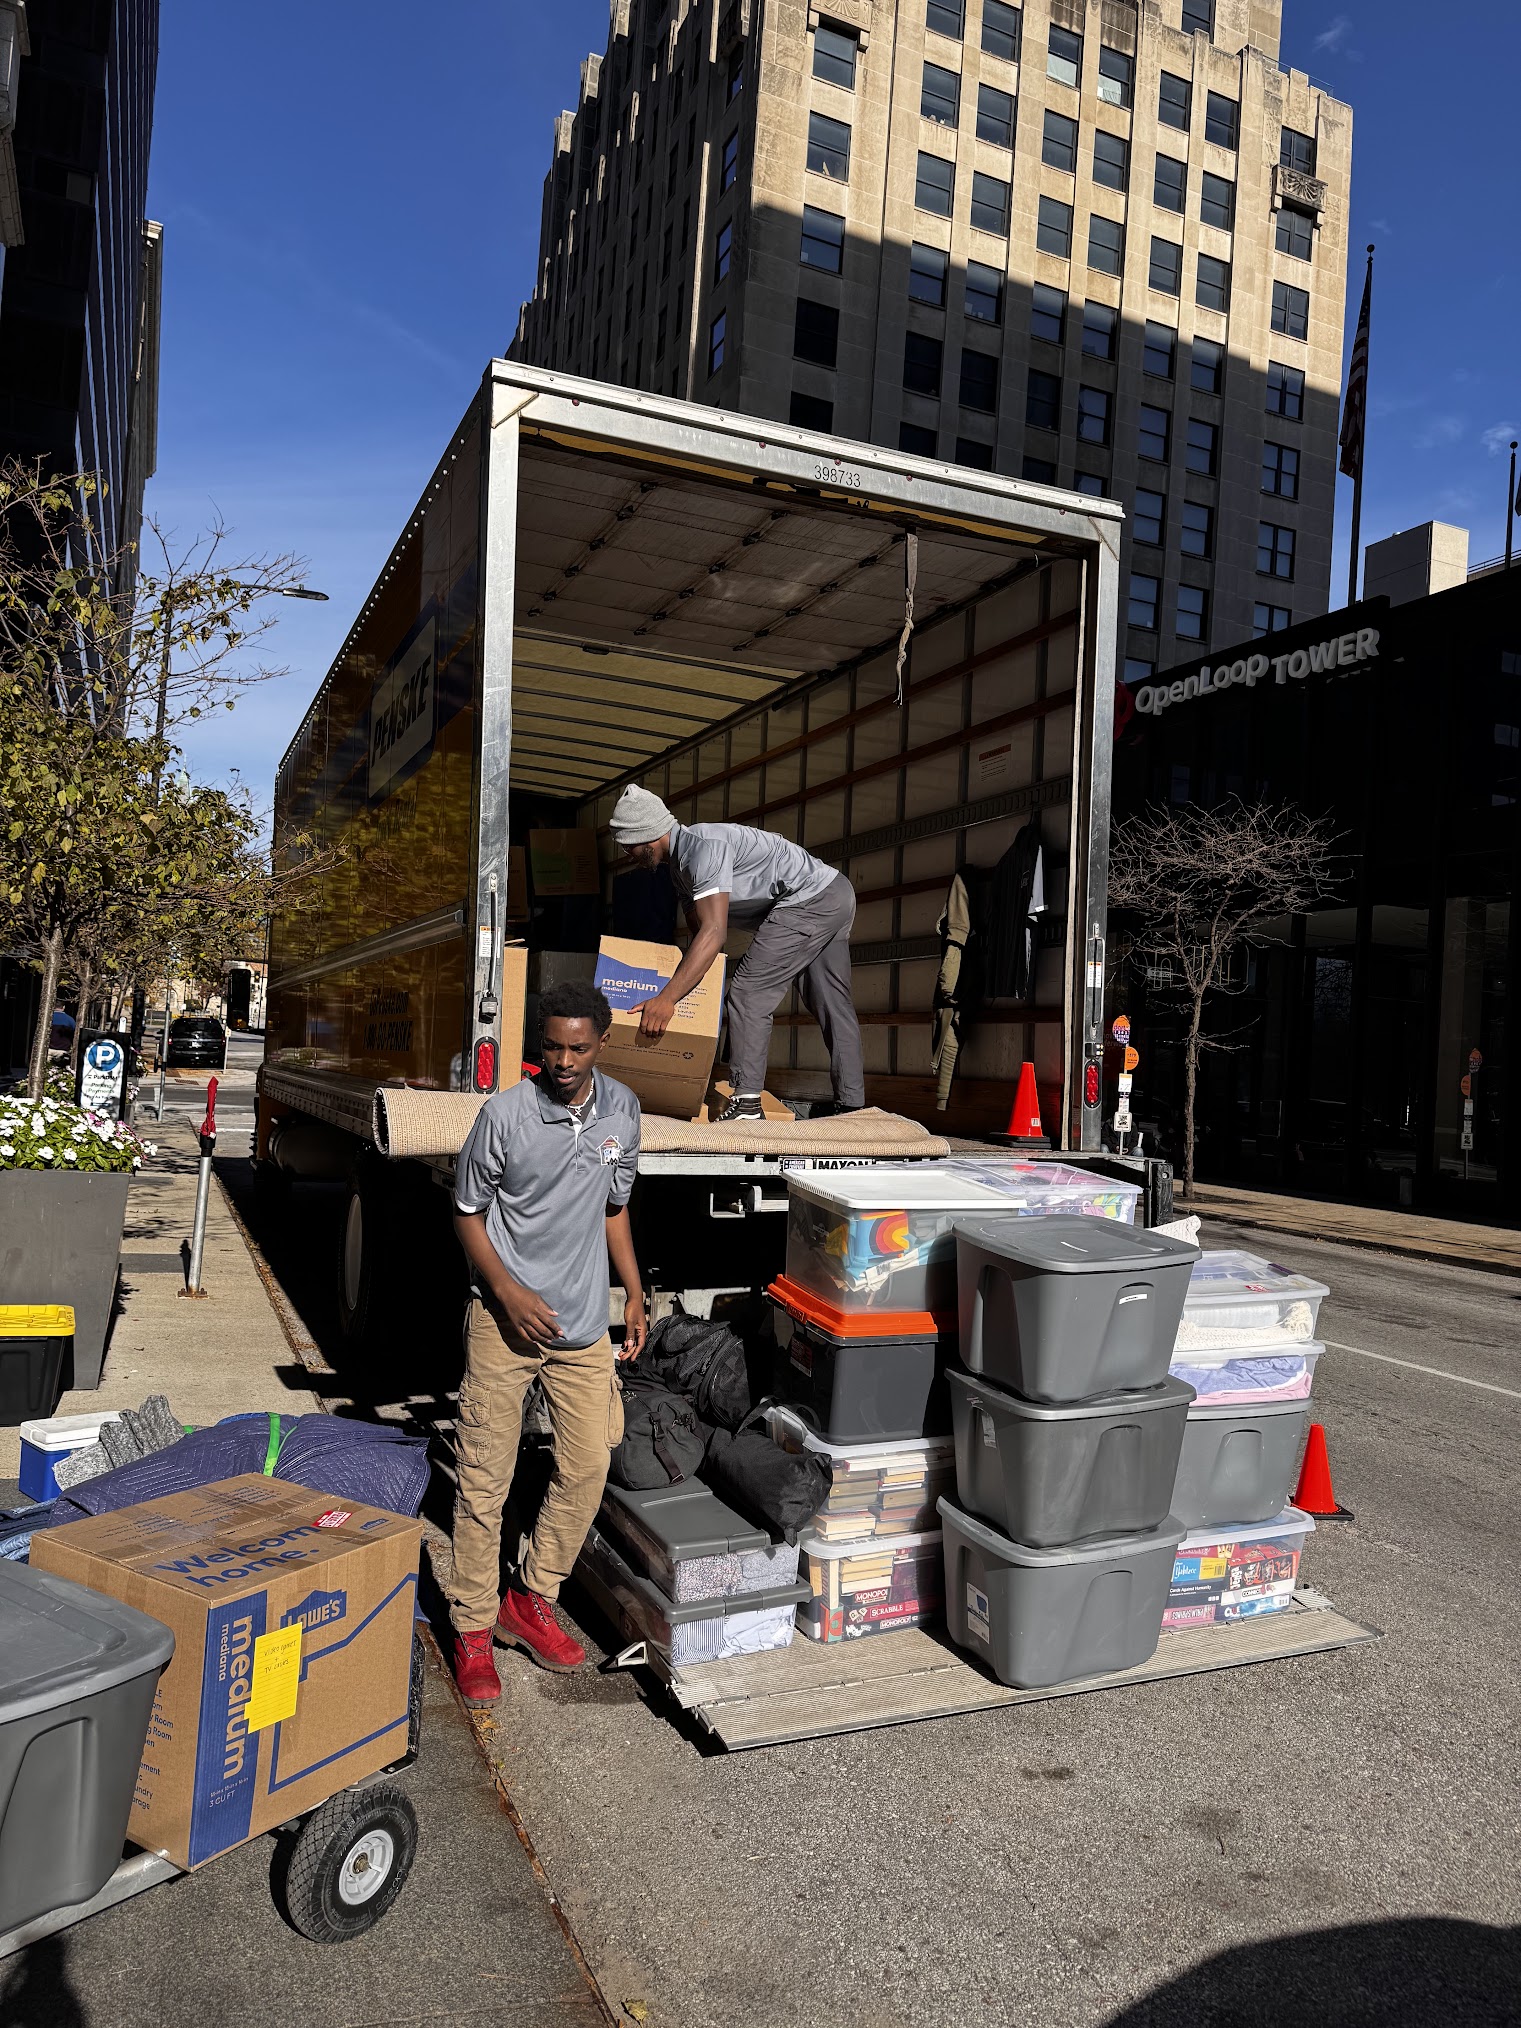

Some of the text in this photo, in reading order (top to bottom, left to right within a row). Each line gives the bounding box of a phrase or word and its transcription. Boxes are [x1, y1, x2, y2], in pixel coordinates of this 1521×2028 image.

[814, 464, 861, 488] 398733
[1135, 627, 1380, 715] OpenLoop TOWER
[371, 653, 432, 768] PENSKE
[602, 977, 659, 993] medium
[95, 1045, 116, 1068] P
[153, 1524, 322, 1576] Welcom
[185, 1548, 320, 1589] home.
[1174, 1564, 1197, 1579] Yahtzee
[1230, 1566, 1242, 1590] Jenga
[871, 1604, 904, 1617] SCRABBLE
[1224, 1605, 1241, 1618] CLUE
[218, 1623, 230, 1681] mediana
[223, 1614, 253, 1779] medium
[154, 1713, 174, 1729] Room
[152, 1727, 172, 1741] Room
[140, 1762, 161, 1776] ement
[135, 1784, 153, 1800] undry
[209, 1799, 214, 1808] 3
[226, 1790, 236, 1800] FT
[132, 1796, 151, 1810] arage
